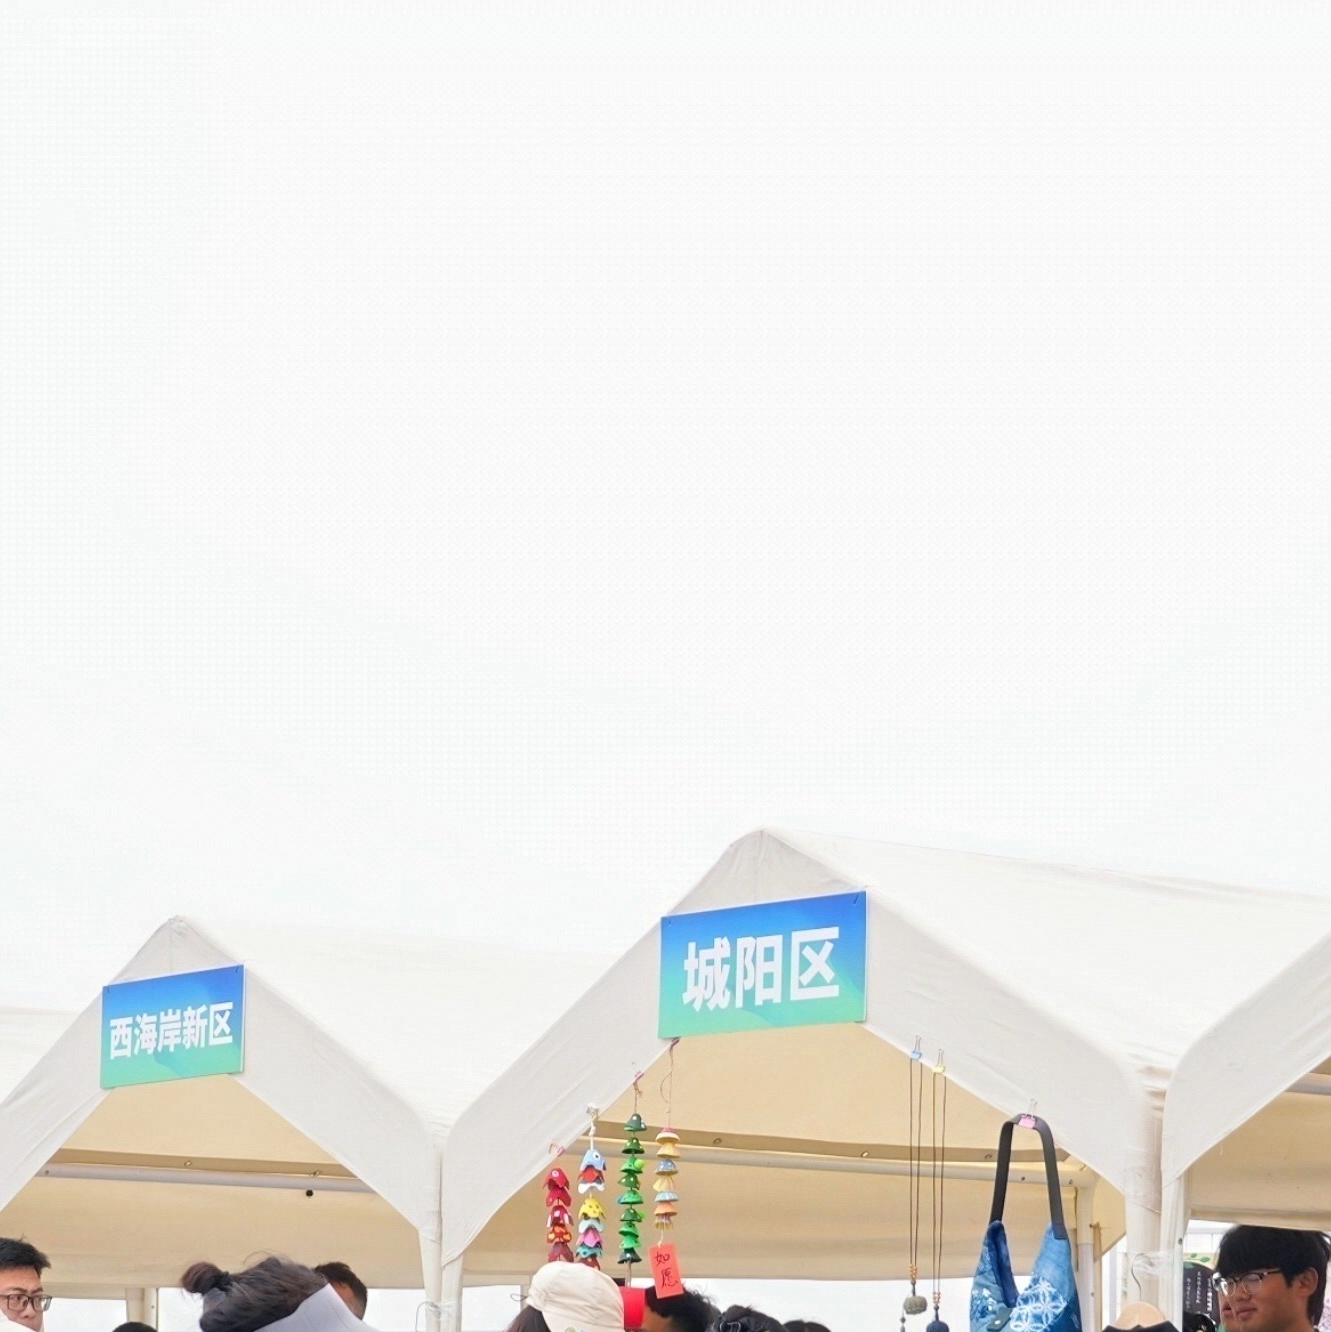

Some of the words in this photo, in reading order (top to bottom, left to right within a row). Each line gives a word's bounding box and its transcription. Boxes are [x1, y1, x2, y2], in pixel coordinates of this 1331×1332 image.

[681, 926, 840, 1011] 城阳区
[109, 1002, 234, 1060] 西海岸新区
[654, 1251, 679, 1289] 如愿
